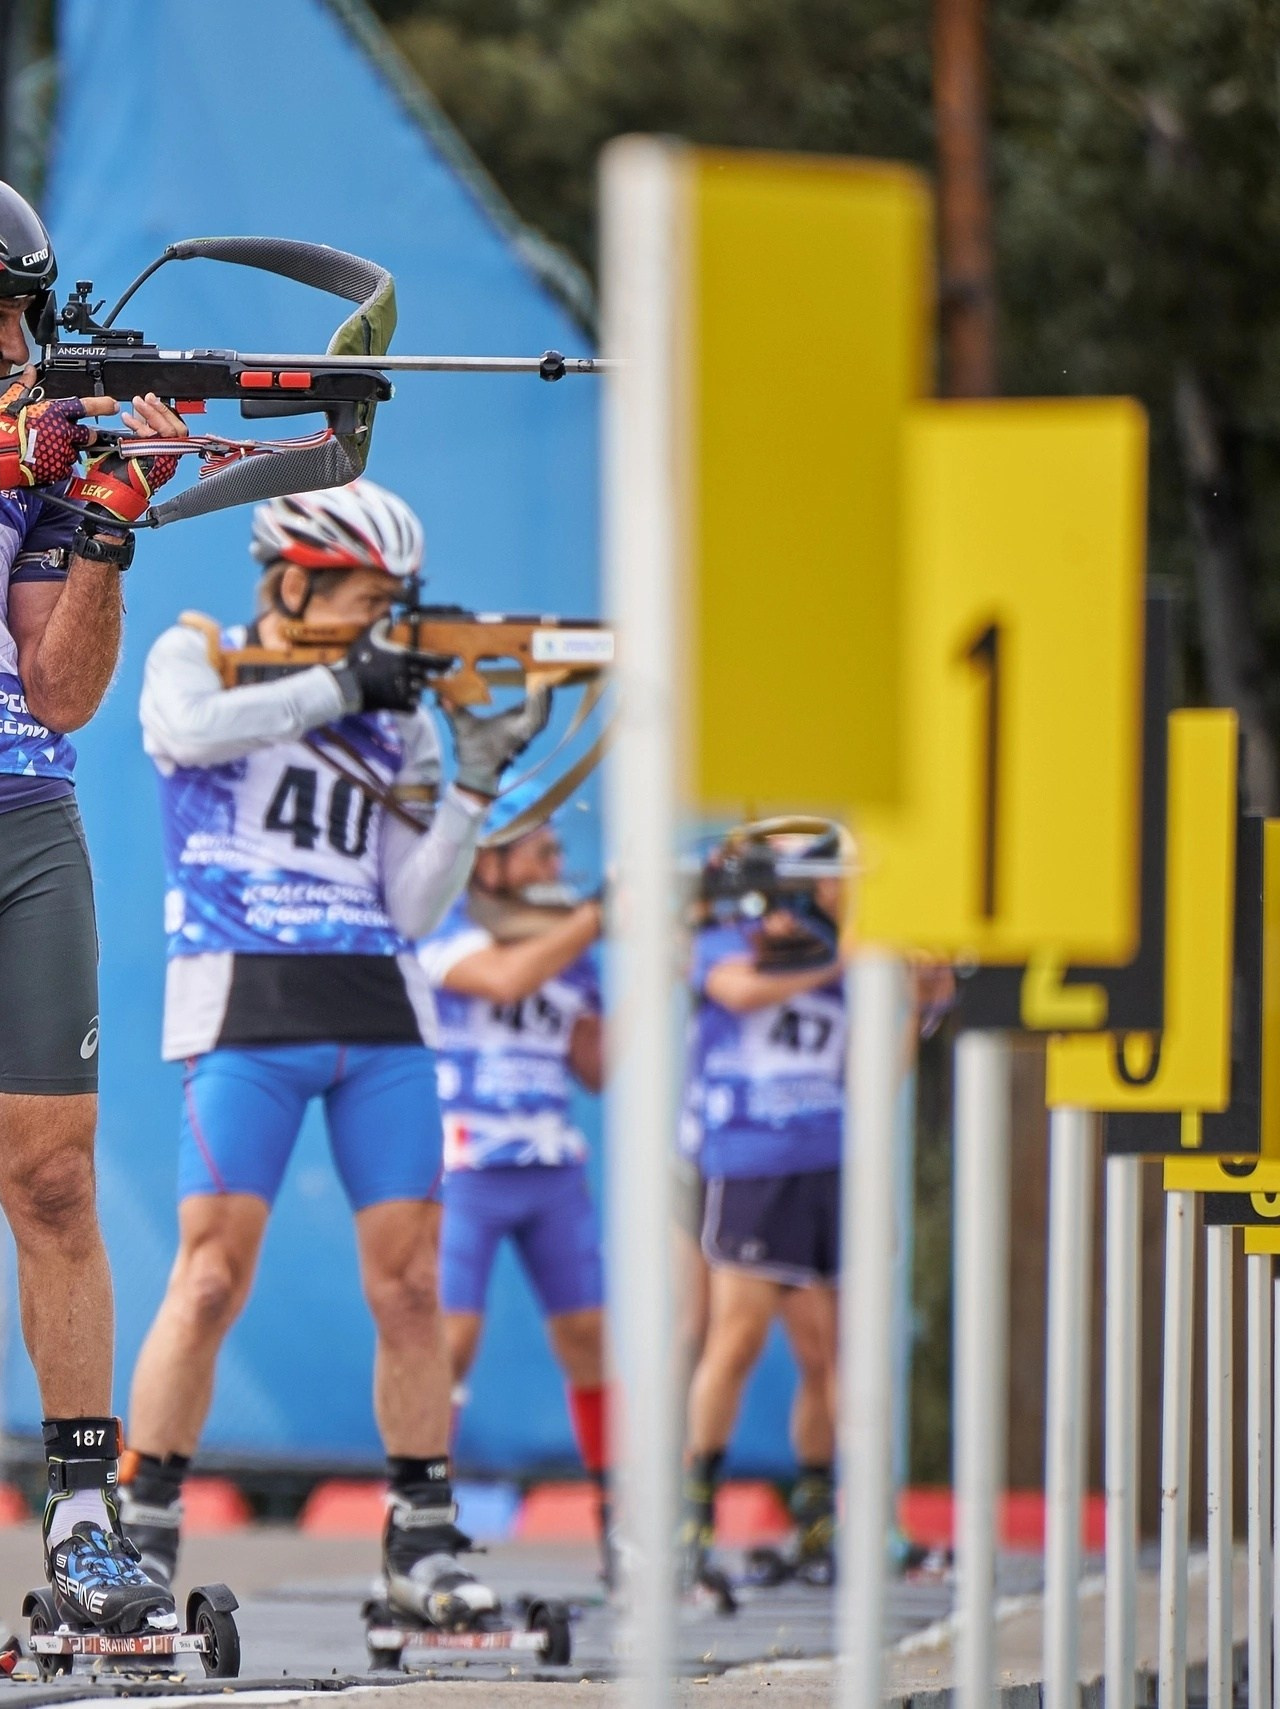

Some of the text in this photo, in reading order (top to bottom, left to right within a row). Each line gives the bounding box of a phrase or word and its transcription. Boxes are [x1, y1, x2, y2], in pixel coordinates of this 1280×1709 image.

[22, 248, 49, 267] GIRO
[80, 483, 114, 500] LEKI
[954, 615, 1001, 922] 1
[264, 766, 372, 860] 40
[72, 1429, 105, 1447] 187
[55, 1570, 109, 1615] SPINE
[99, 1637, 136, 1652] SKATING
